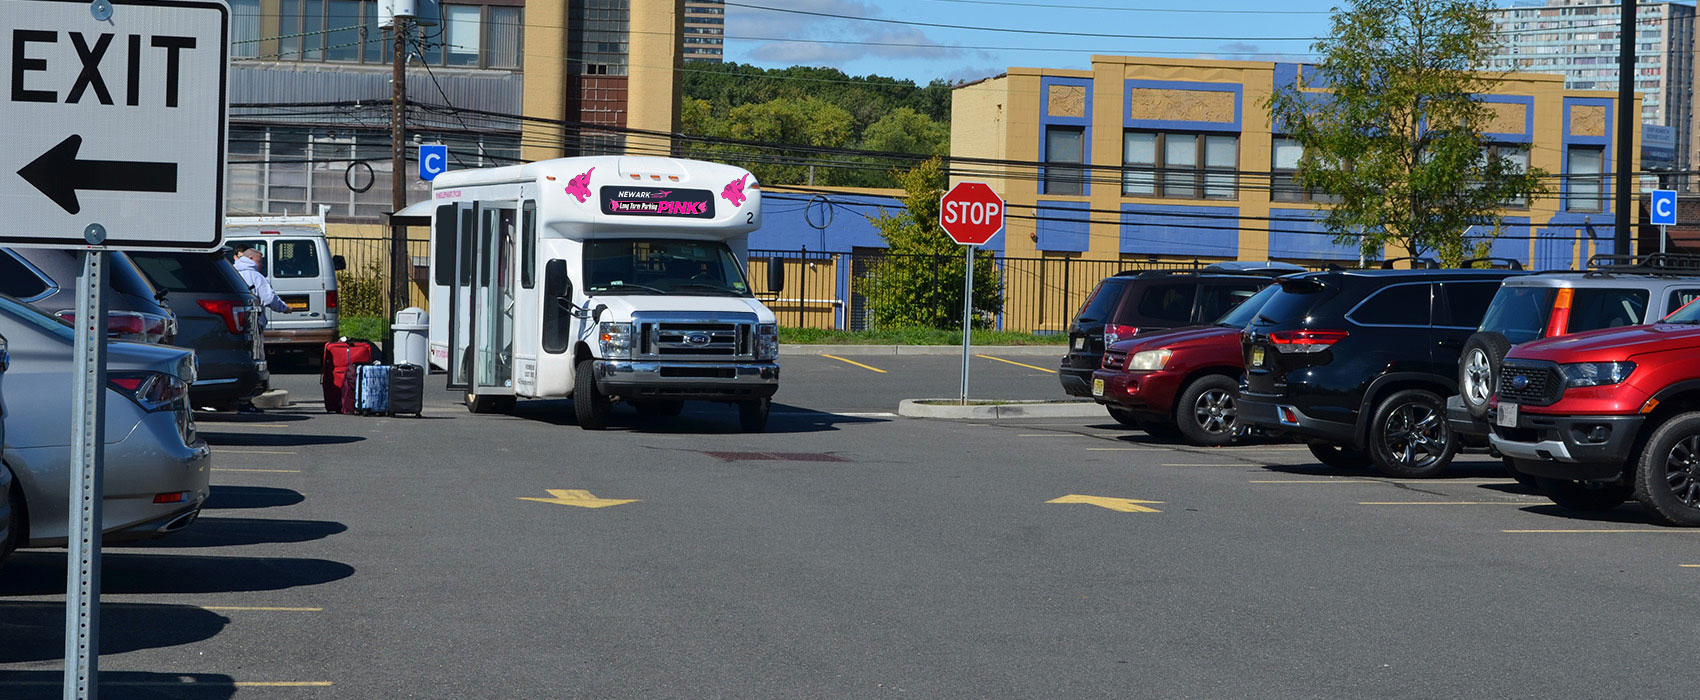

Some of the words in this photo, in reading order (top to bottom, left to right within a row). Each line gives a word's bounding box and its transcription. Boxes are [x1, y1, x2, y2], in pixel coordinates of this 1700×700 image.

[11, 29, 196, 107] EXIT
[425, 153, 440, 173] C
[619, 202, 629, 210] Long
[641, 203, 658, 211] Parking
[657, 200, 701, 214] PINK
[945, 200, 999, 225] STOP
[1656, 198, 1671, 217] C
[746, 211, 754, 224] 2
